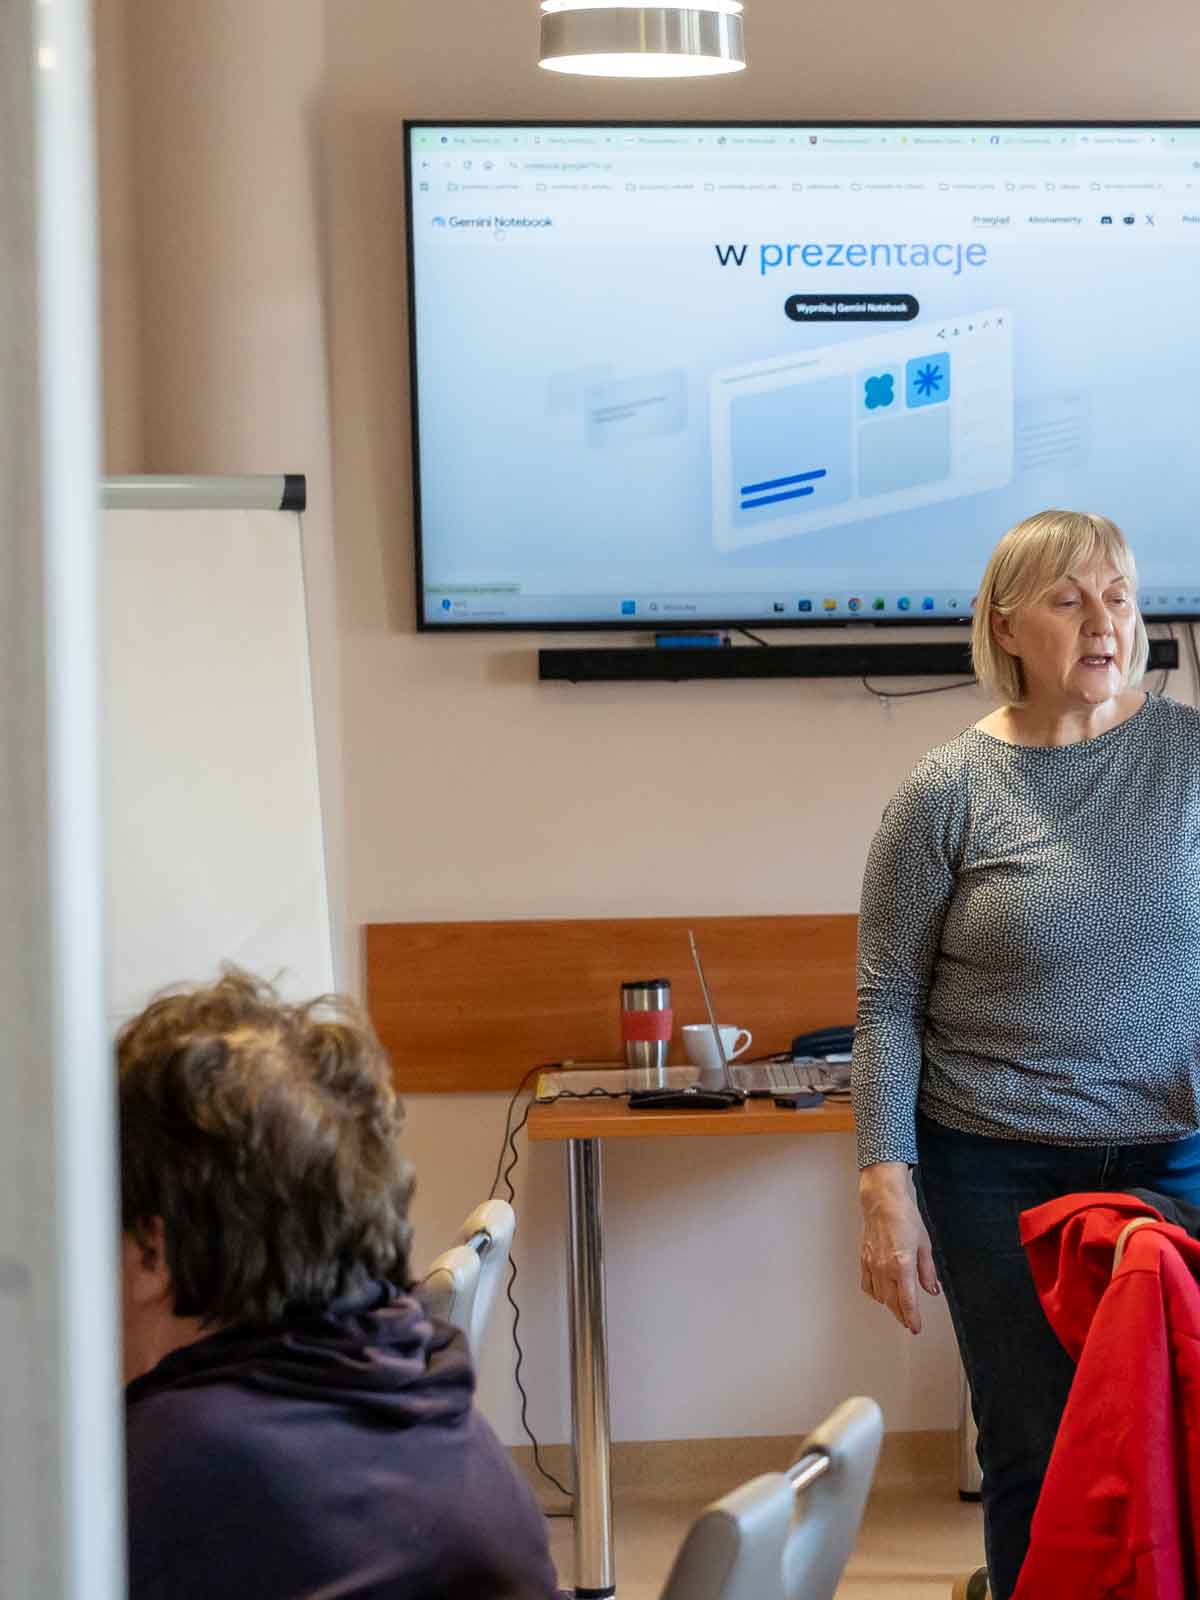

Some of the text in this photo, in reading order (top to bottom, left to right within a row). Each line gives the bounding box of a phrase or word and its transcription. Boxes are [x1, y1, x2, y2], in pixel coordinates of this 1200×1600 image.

[448, 215, 553, 227] Gemini Notebook
[715, 242, 988, 276] w prezentacje
[837, 302, 867, 313] Gemini
[867, 302, 909, 313] Notebook
